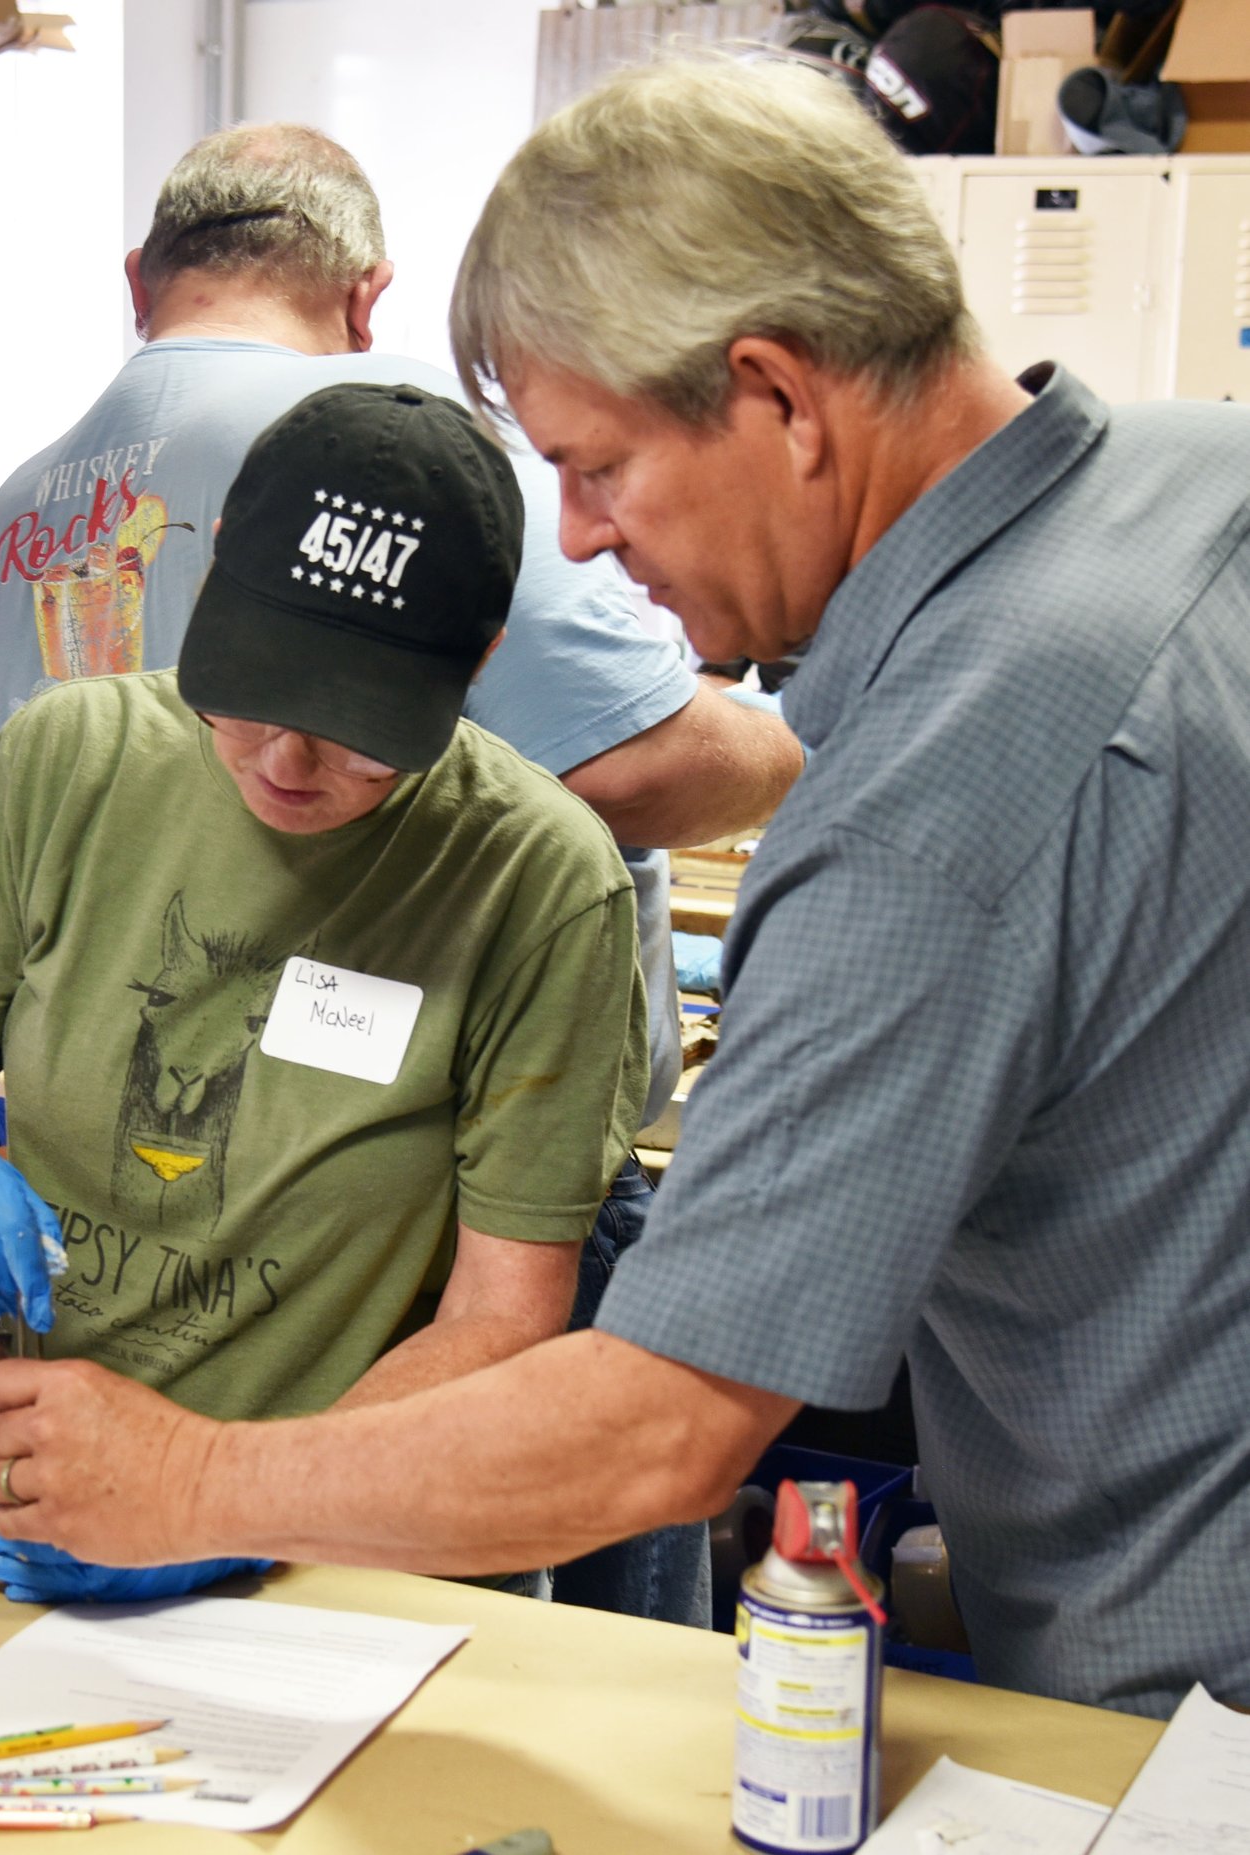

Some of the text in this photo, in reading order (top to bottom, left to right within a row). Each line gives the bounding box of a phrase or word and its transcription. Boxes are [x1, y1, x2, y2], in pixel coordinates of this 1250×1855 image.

[36, 437, 168, 507] WHISKEY
[299, 511, 420, 588] 45/47
[309, 998, 375, 1036] McNeel
[44, 1200, 281, 1318] PSY TINA'S
